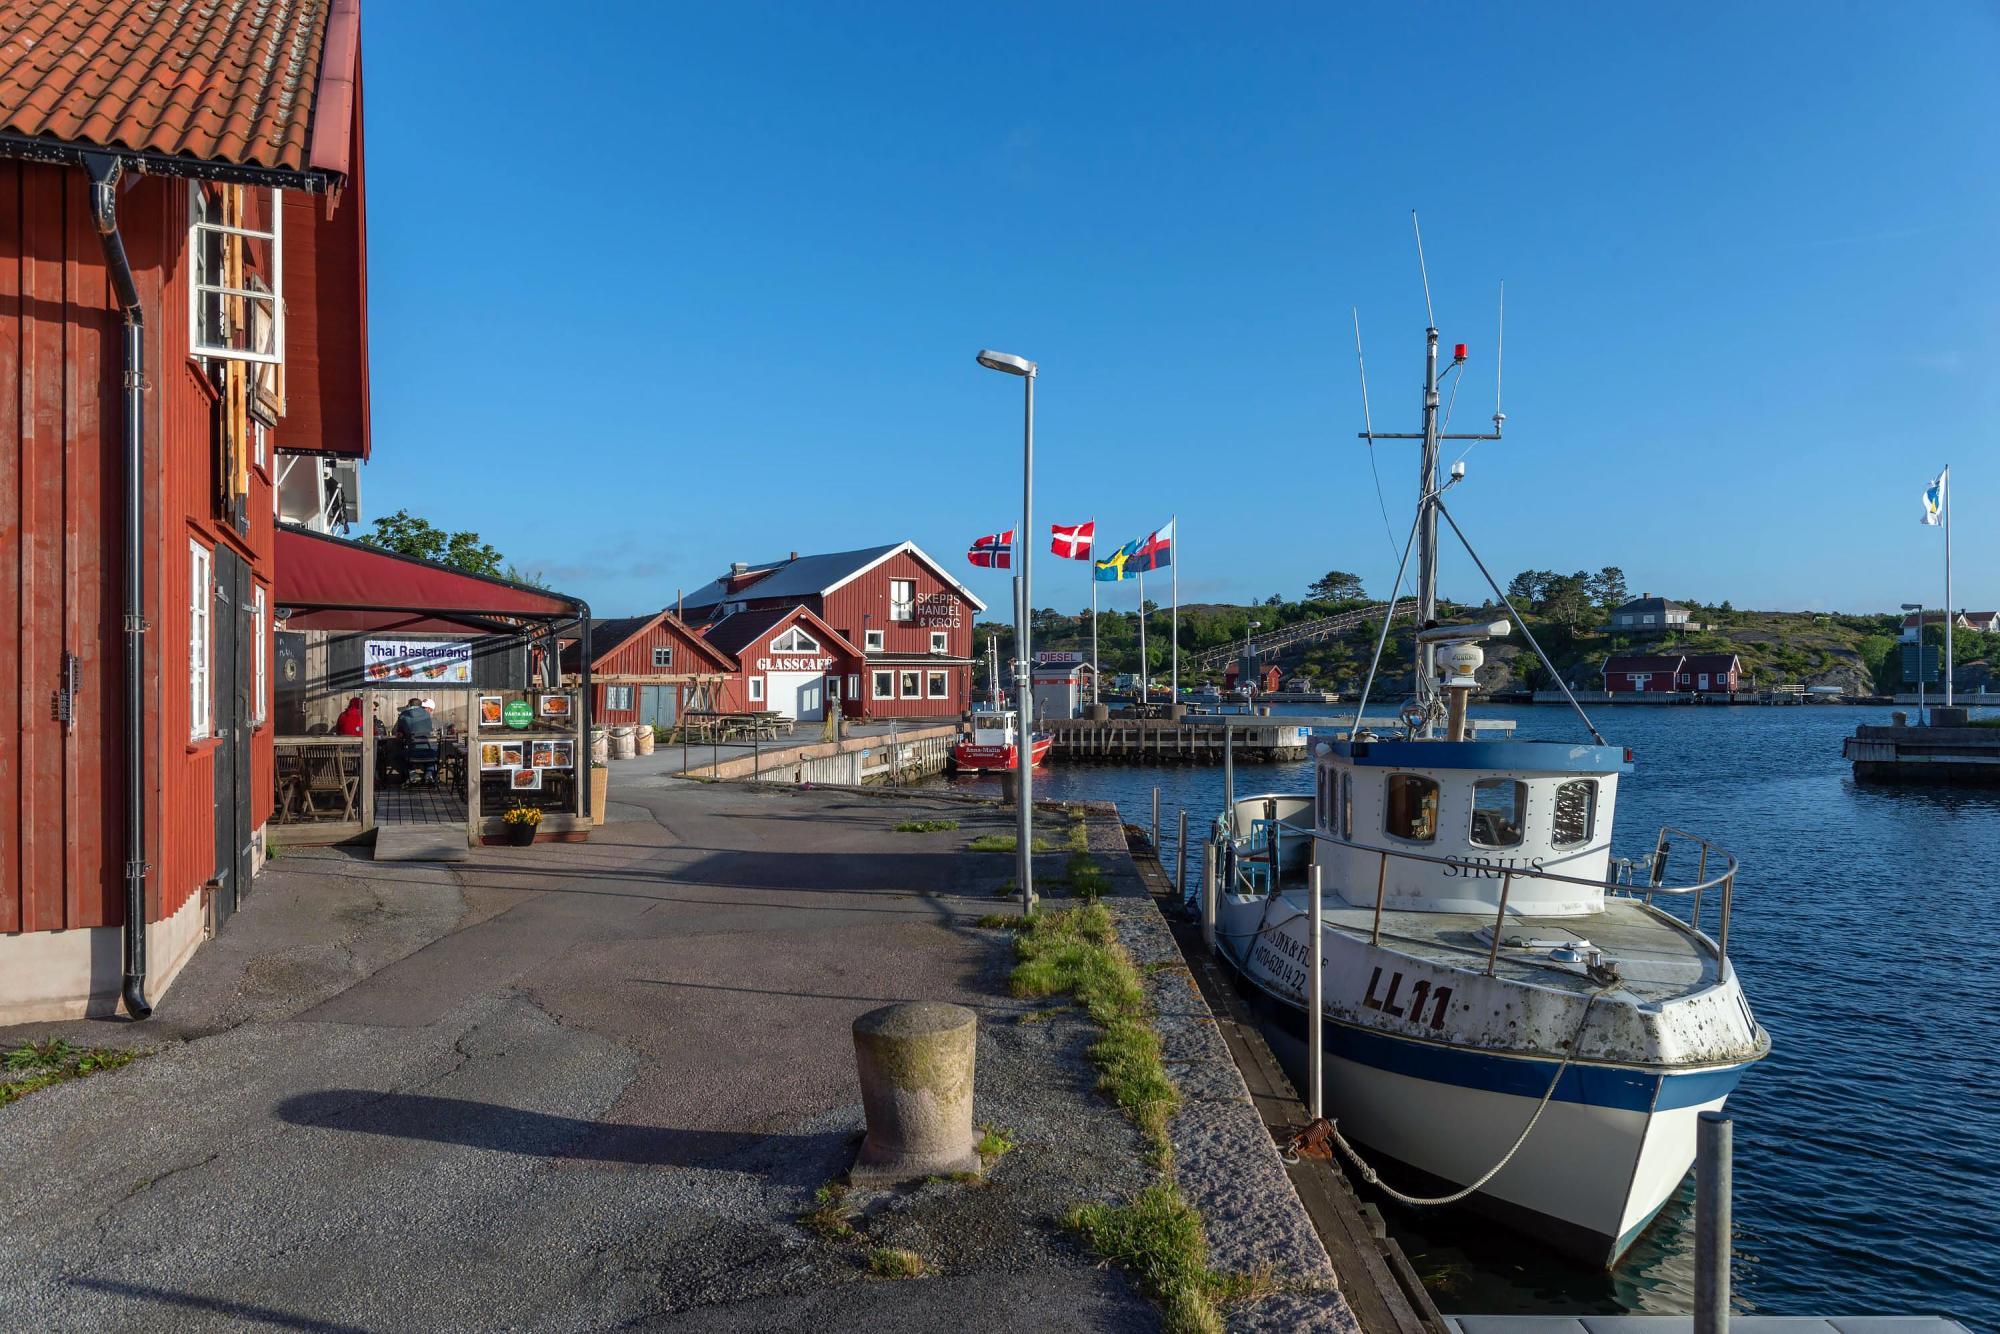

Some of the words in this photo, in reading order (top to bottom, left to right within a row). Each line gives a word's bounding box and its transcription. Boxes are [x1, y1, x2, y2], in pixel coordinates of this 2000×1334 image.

[917, 592, 960, 605] SKEPPS
[917, 605, 961, 616] HANDEL
[919, 617, 926, 627] &
[929, 617, 961, 628] KROG
[370, 645, 396, 657] Thai
[400, 646, 469, 661] Restaurang
[1040, 653, 1076, 662] DIESEL
[756, 656, 833, 670] GLASSCAFÉ
[1443, 855, 1544, 879] SIRIUS
[1290, 969, 1306, 991] 22
